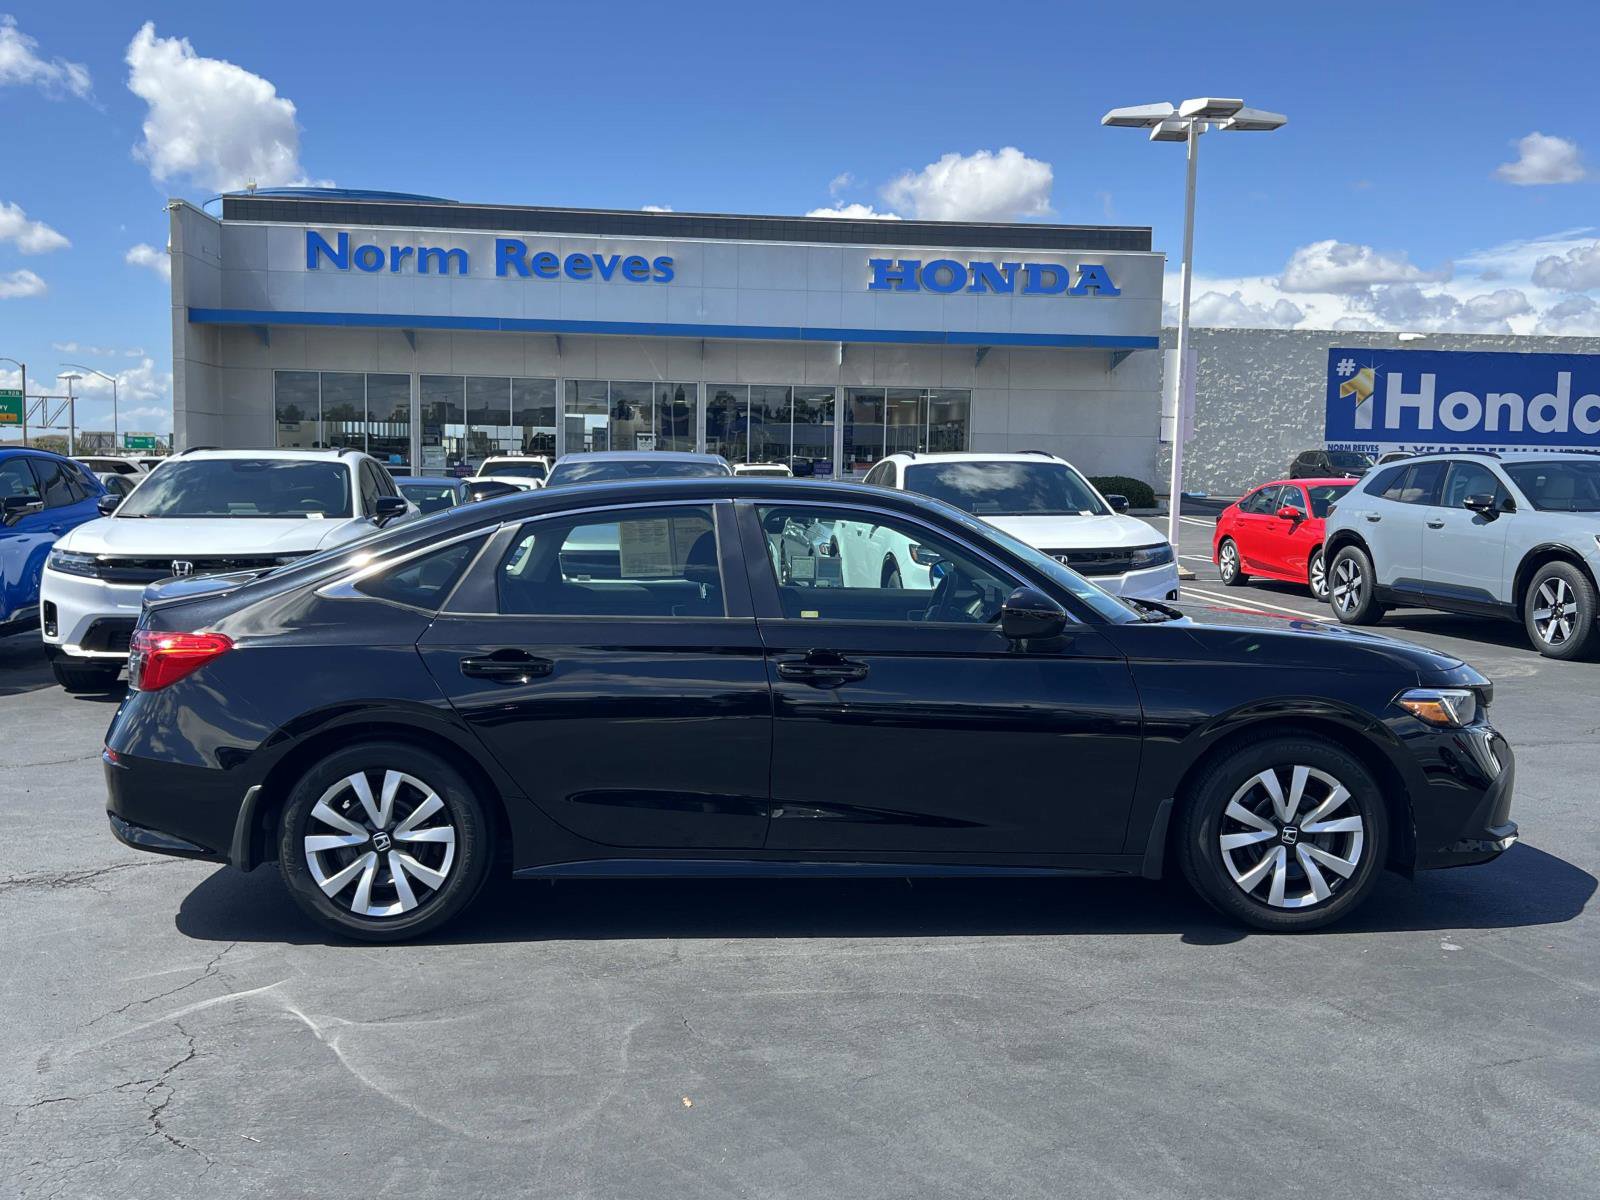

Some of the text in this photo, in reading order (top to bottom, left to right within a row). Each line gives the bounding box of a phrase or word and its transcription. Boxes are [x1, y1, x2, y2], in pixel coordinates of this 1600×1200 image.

[305, 230, 675, 284] Norm Reeves
[867, 258, 1122, 296] HONDA
[1328, 443, 1380, 452] NORM REEVES
